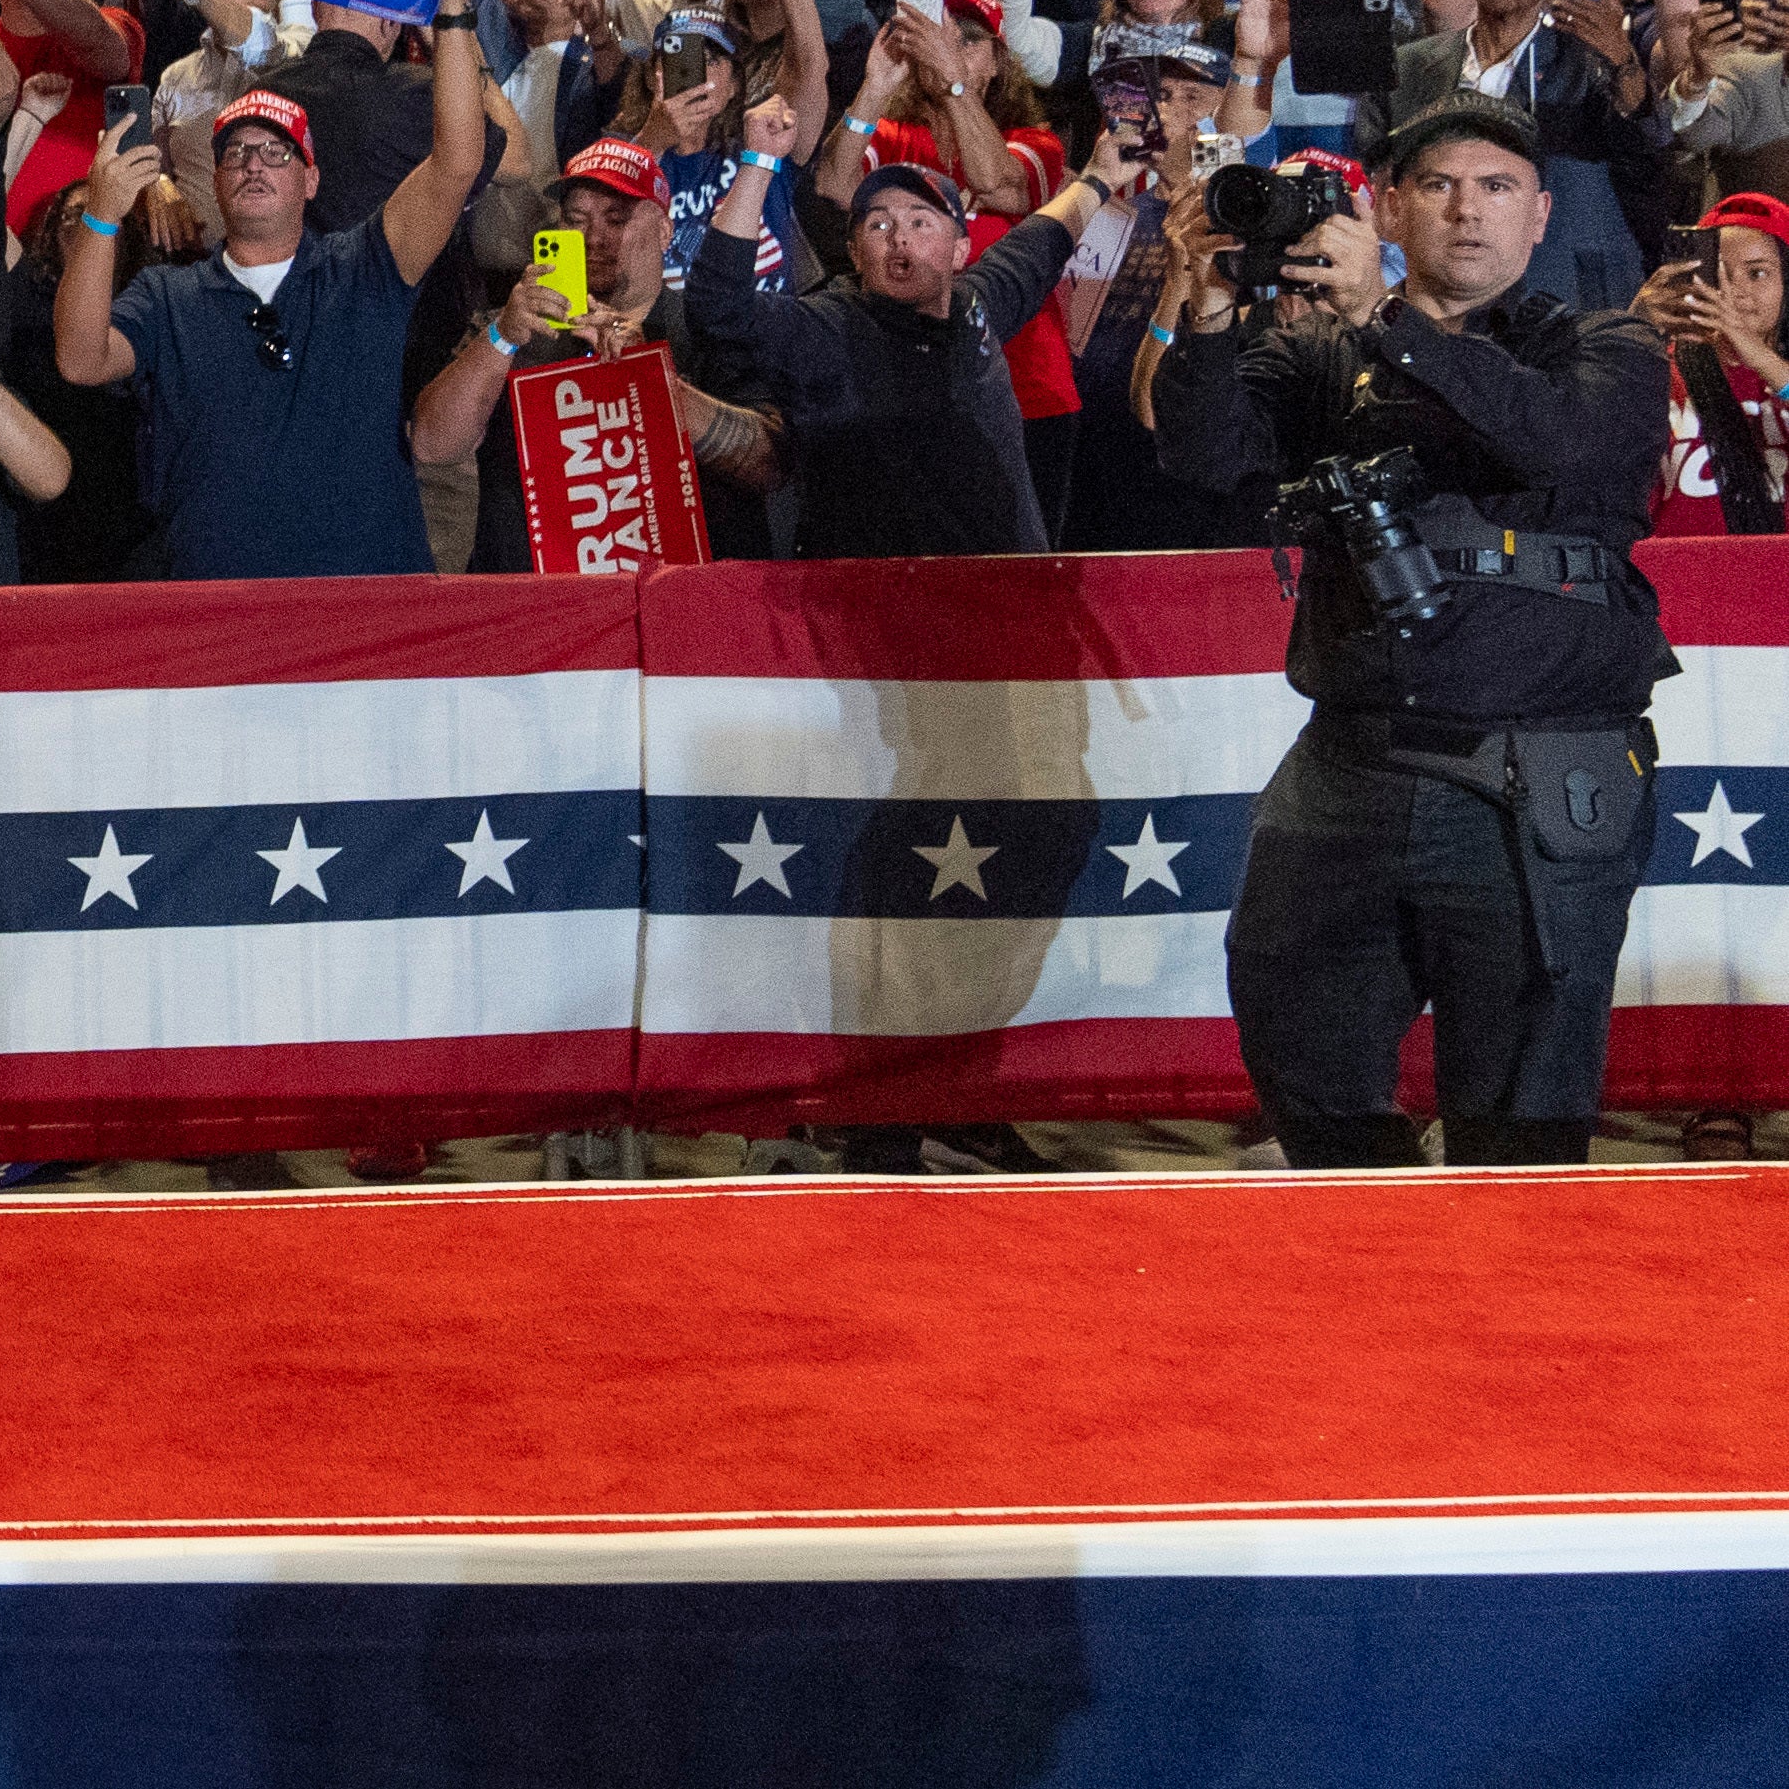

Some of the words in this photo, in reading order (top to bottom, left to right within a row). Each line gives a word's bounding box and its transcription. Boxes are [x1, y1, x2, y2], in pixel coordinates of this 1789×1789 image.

[670, 9, 727, 24] TRUMP
[249, 93, 301, 117] AMERICA
[259, 108, 293, 128] AGAIN
[597, 141, 650, 167] AMERICA
[602, 158, 640, 181] AGAIN
[631, 382, 648, 434] AGAIN!
[554, 378, 619, 573] RUMP
[637, 438, 654, 489] GREAT
[680, 460, 700, 509] 2024
[643, 491, 663, 555] AMERICA
